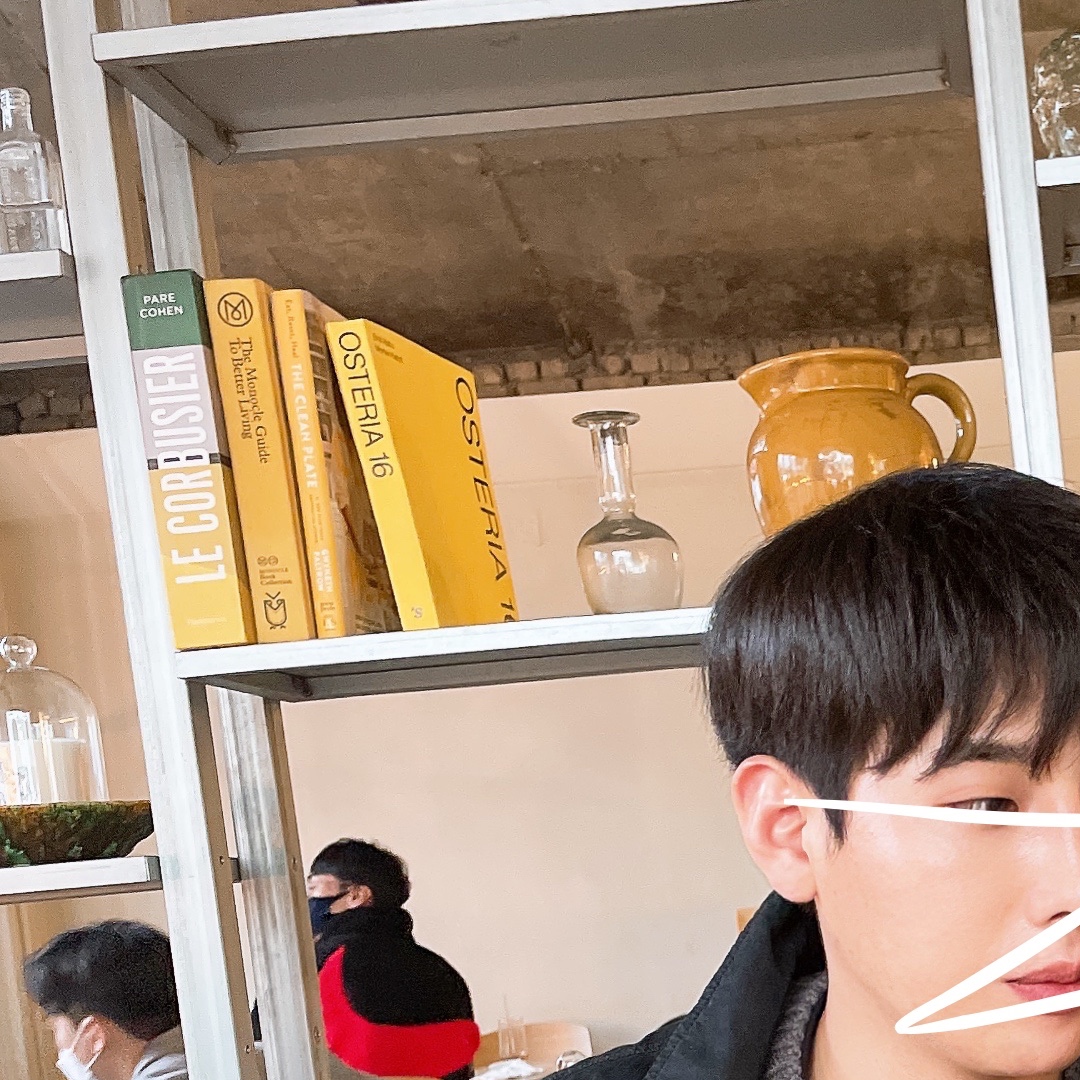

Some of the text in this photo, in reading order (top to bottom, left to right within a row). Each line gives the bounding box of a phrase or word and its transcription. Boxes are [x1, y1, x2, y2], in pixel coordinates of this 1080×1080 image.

[139, 304, 184, 319] COHEN
[143, 292, 177, 305] PARE
[228, 337, 253, 440] To Better Living
[240, 337, 271, 464] The Monocle Guide
[291, 363, 305, 391] THE
[295, 394, 311, 442] CLEAN
[338, 331, 385, 448] OSTERIA
[368, 452, 394, 479] 16
[143, 351, 220, 536] CORBUSIER
[303, 446, 318, 489] PLATE
[455, 376, 509, 582] OSTERIA
[171, 544, 227, 585] LE
